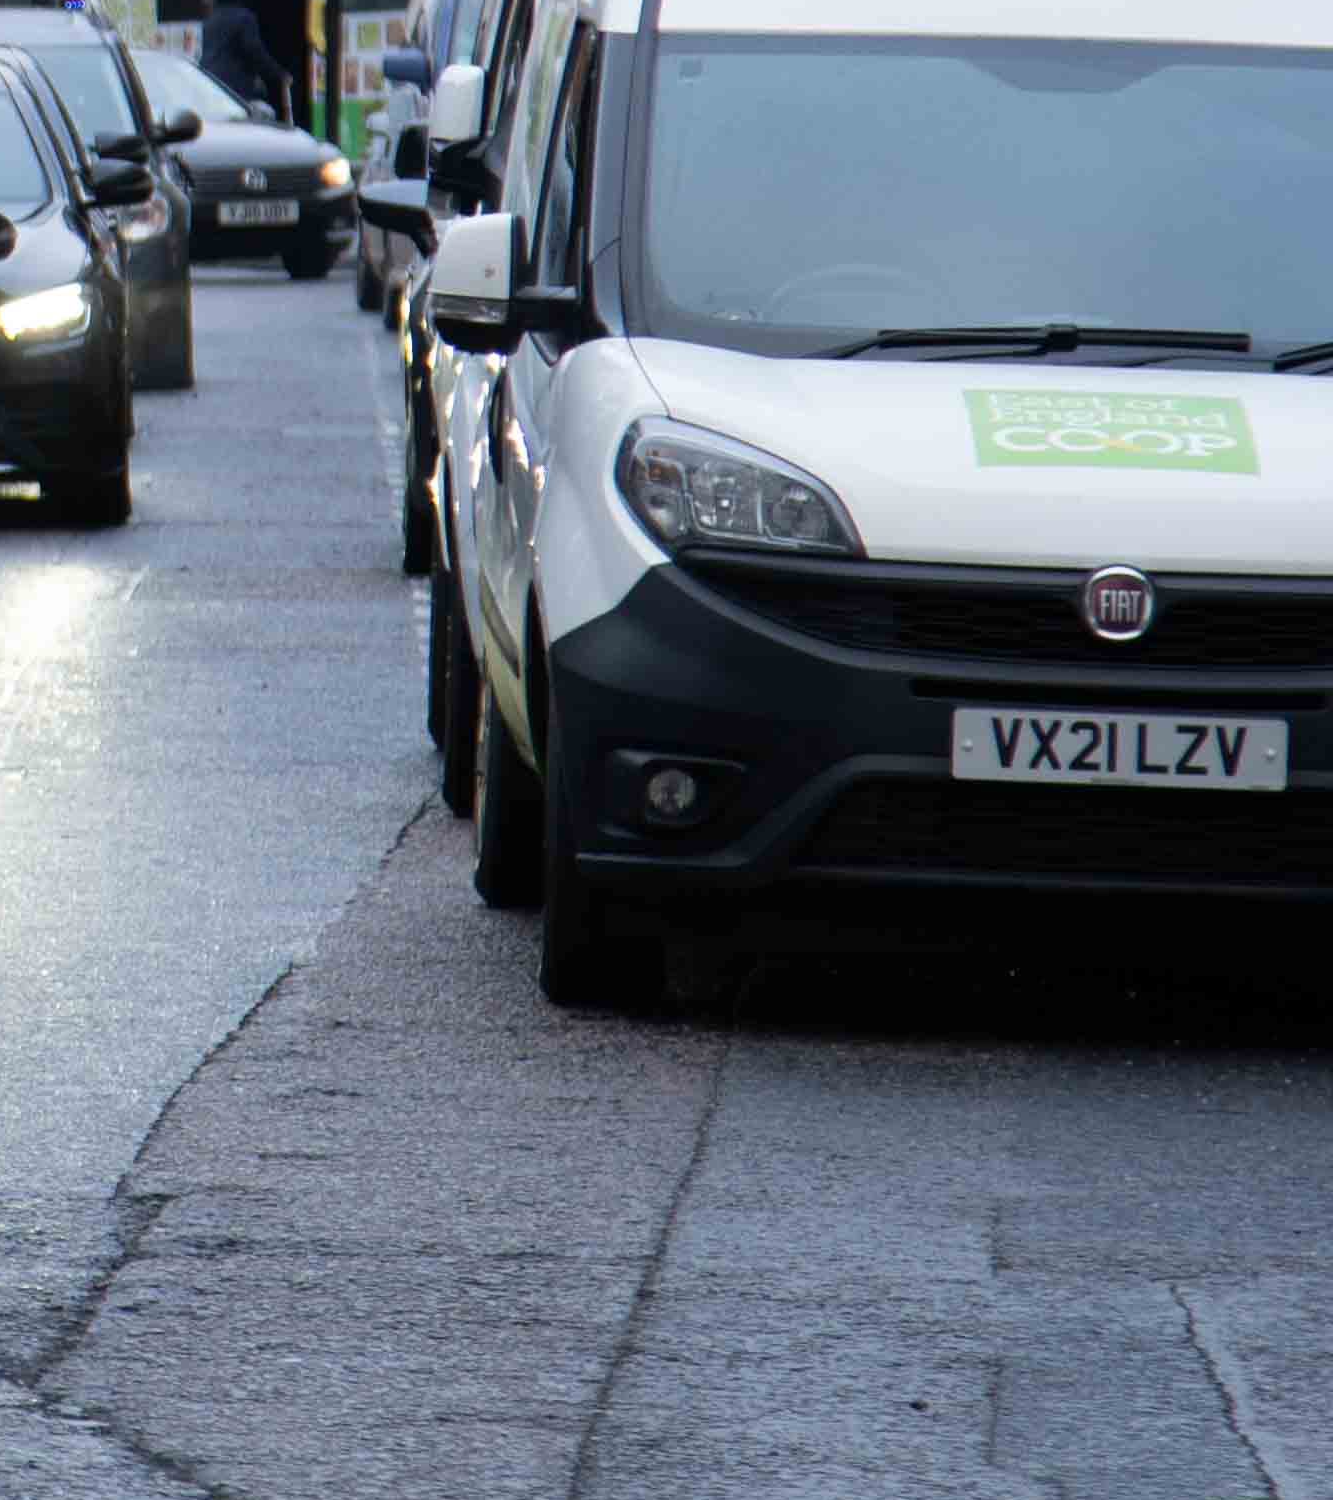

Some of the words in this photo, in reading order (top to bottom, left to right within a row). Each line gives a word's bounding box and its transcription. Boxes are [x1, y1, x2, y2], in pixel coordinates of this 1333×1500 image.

[1100, 589, 1141, 623] FIAT
[991, 716, 1118, 773] VX21
[1136, 722, 1248, 777] LZV
